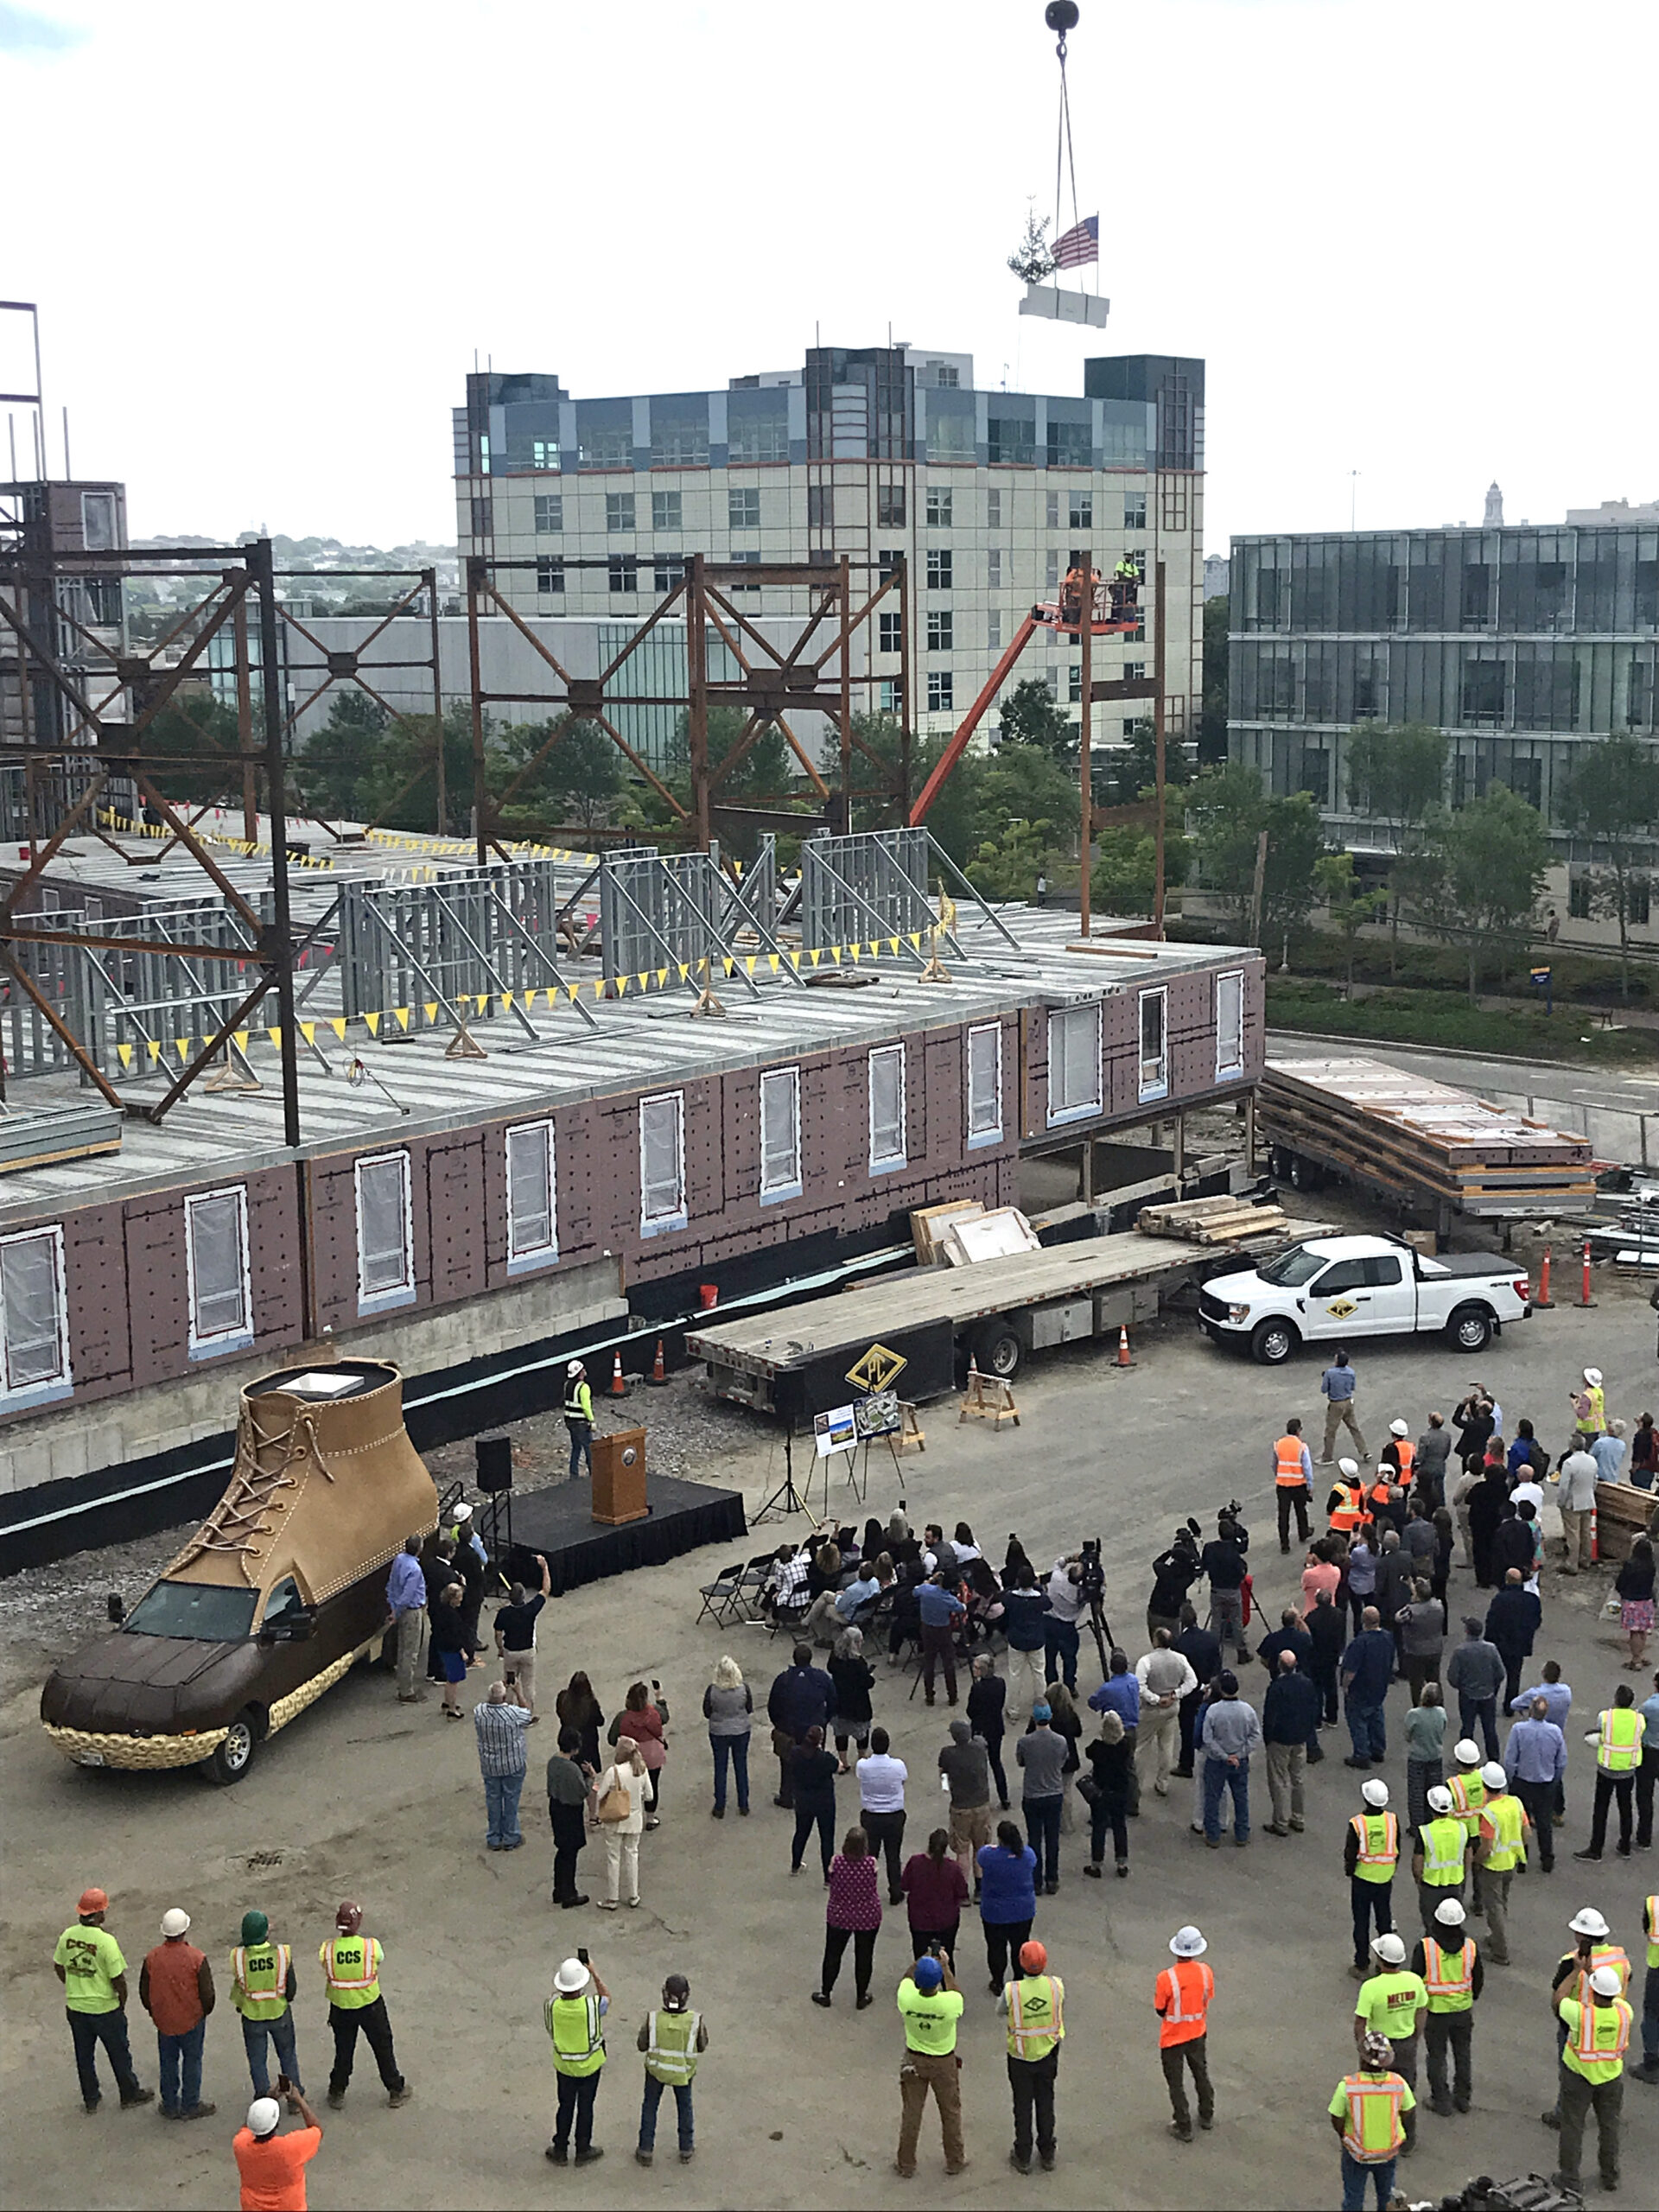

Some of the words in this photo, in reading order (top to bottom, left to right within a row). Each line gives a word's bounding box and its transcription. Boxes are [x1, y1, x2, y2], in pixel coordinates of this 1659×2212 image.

[66, 1938, 97, 1957] CCS
[249, 1957, 274, 1973] CCS
[336, 1950, 361, 1965] CCS
